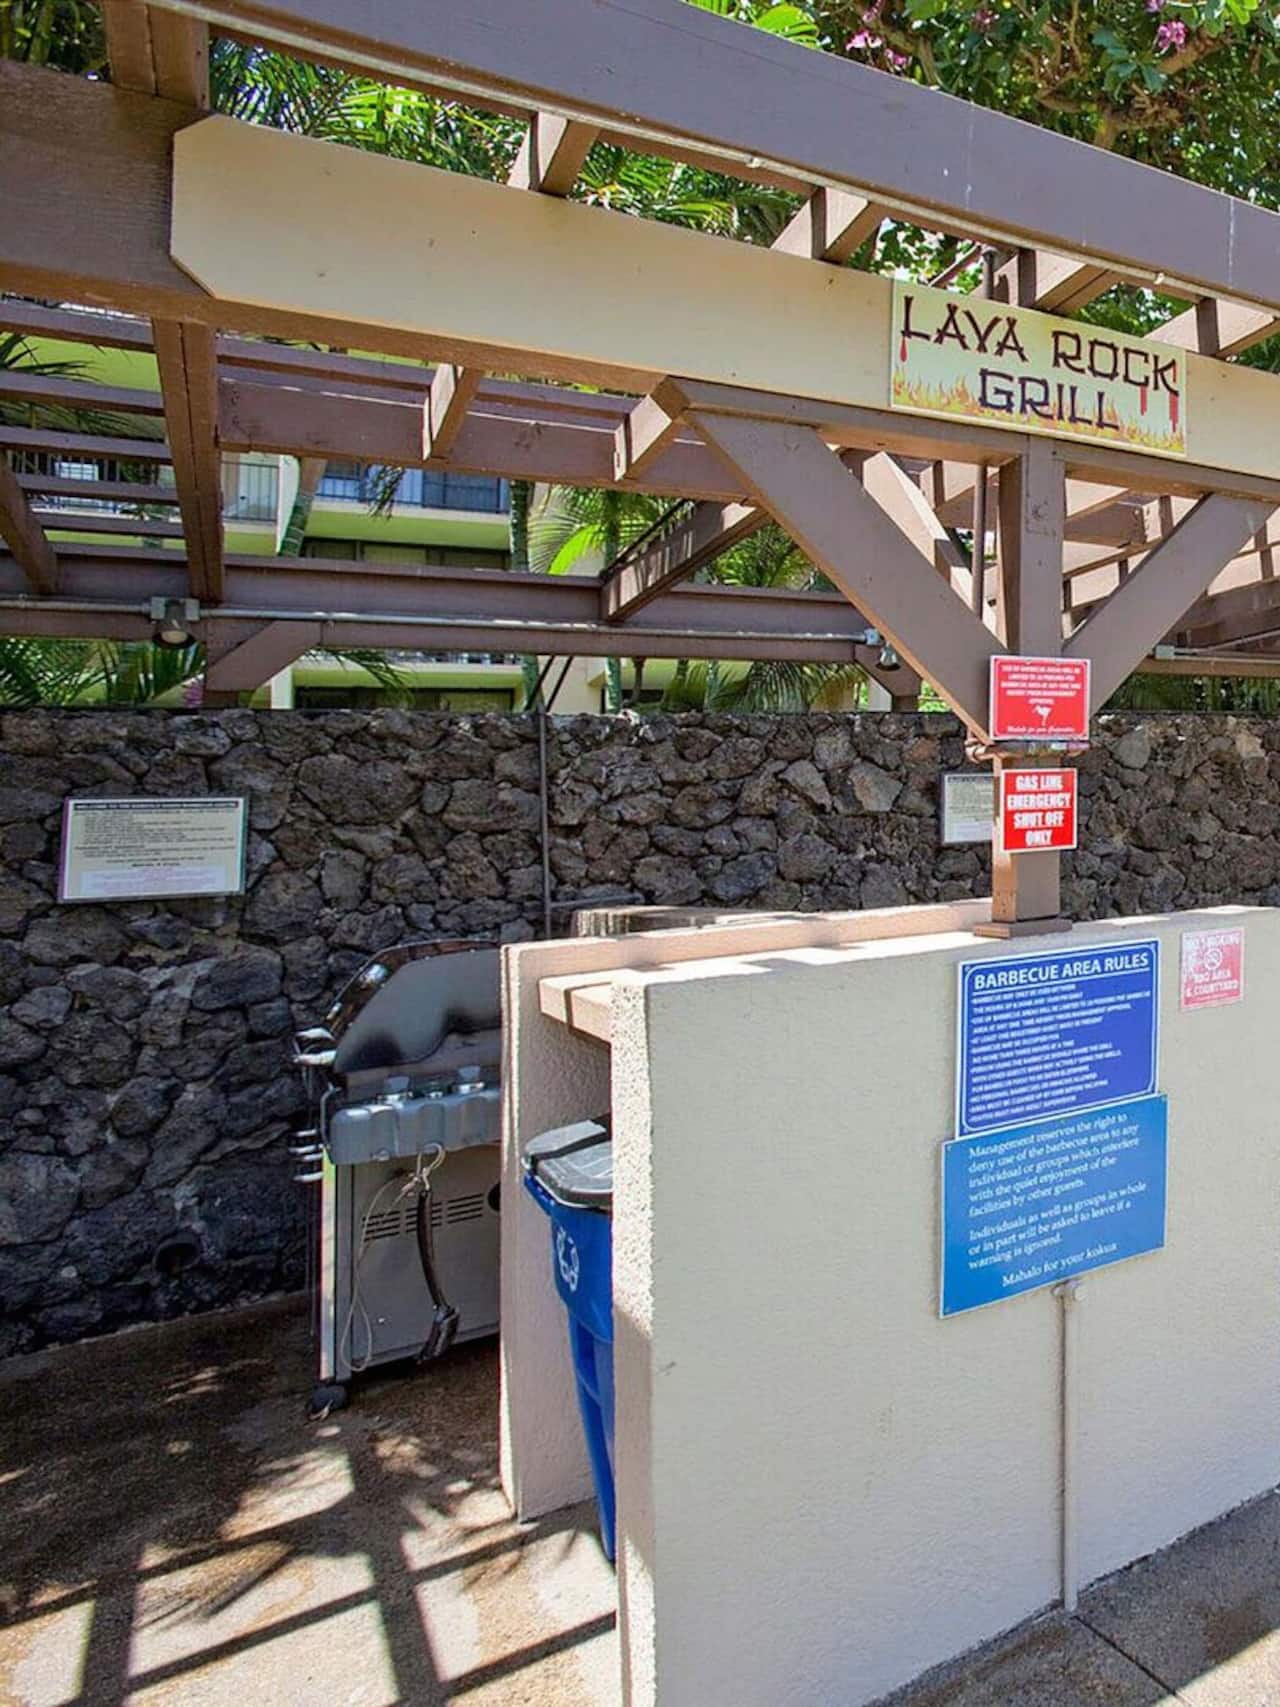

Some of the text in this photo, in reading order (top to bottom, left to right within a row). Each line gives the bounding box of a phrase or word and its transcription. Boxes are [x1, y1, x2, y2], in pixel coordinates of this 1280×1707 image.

[1052, 330, 1179, 395] ROCK
[978, 367, 1120, 430] GRILL
[1007, 792, 1072, 810] EMERGENCY
[1016, 775, 1063, 791] GAS LINE
[1013, 811, 1064, 829] SHUT OFF
[1025, 829, 1053, 846] ONLY
[974, 952, 1149, 989] BARBECUE AREA RULES
[968, 1158, 994, 1174] deny
[1016, 1149, 1027, 1163] of
[1028, 1146, 1044, 1159] the
[1046, 1135, 1089, 1154] barbecue
[1112, 1128, 1121, 1138] to
[1122, 1124, 1139, 1137] any
[969, 1114, 1127, 1158] Management reserves the right to
[969, 1165, 1022, 1188] individual
[1024, 1165, 1034, 1174] or
[1035, 1154, 1069, 1173] groups
[1071, 1147, 1100, 1161] which
[969, 1155, 1118, 1202] with the quiet enjoyment of the
[969, 1198, 1011, 1217] facilities
[1013, 1196, 1025, 1208] by
[1027, 1187, 1051, 1200] other
[969, 1217, 1026, 1241] Individuals
[1028, 1214, 1038, 1224] as
[1040, 1206, 1060, 1220] well
[1074, 1195, 1107, 1214] groups
[1119, 1182, 1146, 1197] whole
[968, 1246, 981, 1255] or
[983, 1240, 993, 1251] in
[995, 1235, 1016, 1253] part
[1018, 1227, 1036, 1241] will
[1038, 1223, 1050, 1235] be
[1051, 1215, 1079, 1231] asked
[1080, 1213, 1090, 1223] to
[1092, 1206, 1116, 1219] leave
[969, 1252, 1011, 1270] warning
[1024, 1235, 1062, 1255] ignored.
[1003, 1242, 1118, 1287] Mahalo for your kokua
